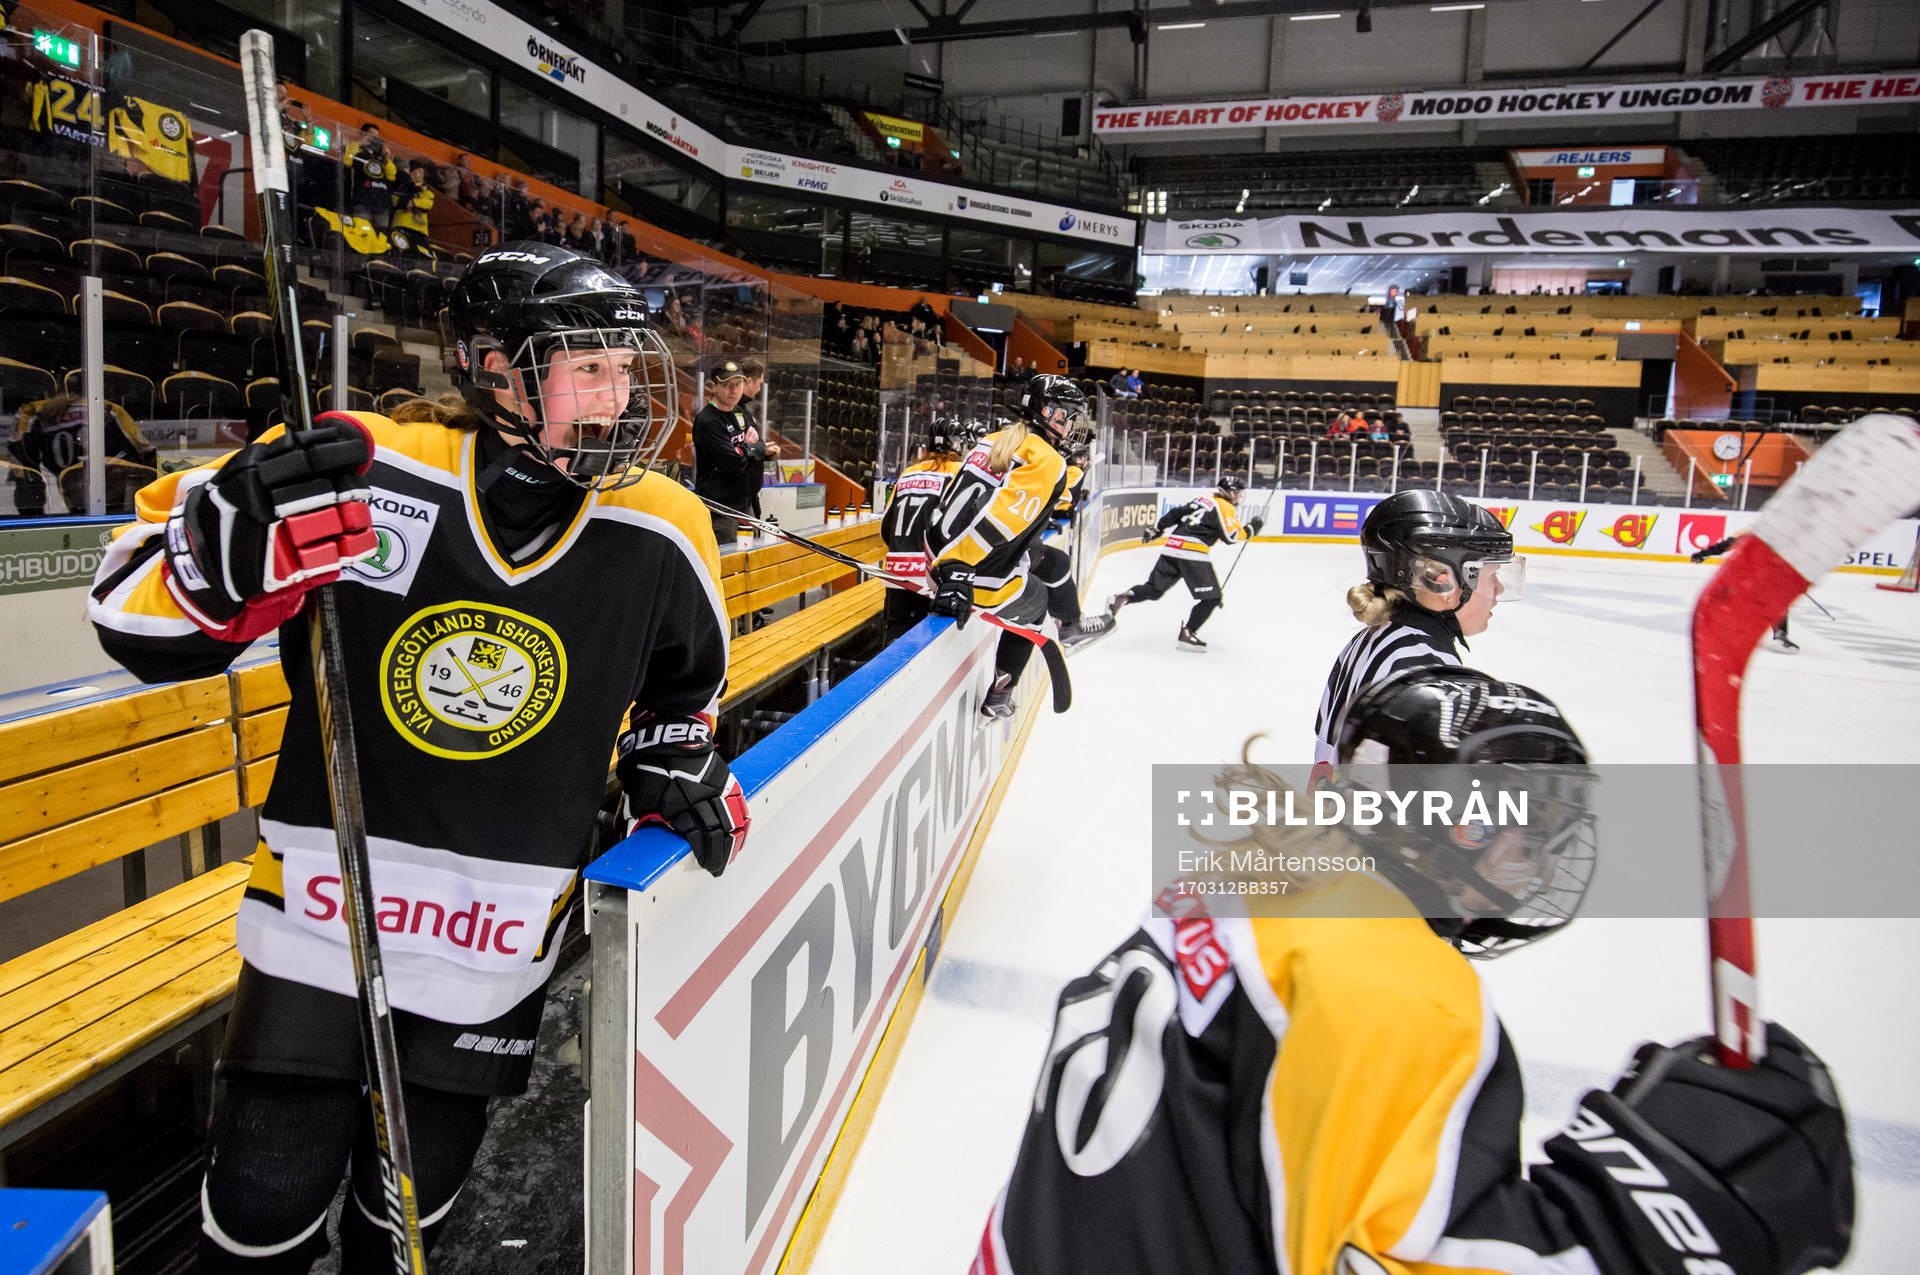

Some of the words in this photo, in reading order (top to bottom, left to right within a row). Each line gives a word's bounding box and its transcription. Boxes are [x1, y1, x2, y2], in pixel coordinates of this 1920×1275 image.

[1410, 95, 1493, 115] MODO
[1502, 91, 1615, 113] HOCKEY
[1619, 85, 1753, 108] UNGDOM
[1804, 80, 1865, 100] THE
[50, 79, 104, 129] 24
[1095, 112, 1140, 129] THE
[1144, 106, 1225, 127] HEART
[1229, 105, 1262, 123] OF
[1265, 100, 1371, 122] HOCKEY
[792, 160, 837, 174] KNIGHTEC
[1556, 151, 1631, 164] REJLERS
[754, 169, 780, 178] BEIJER
[797, 178, 829, 191] KPMG
[1078, 219, 1119, 237] IMERYS
[1300, 217, 1871, 249] Nordemans
[478, 251, 550, 265] CCM
[615, 309, 645, 321] CCM
[367, 496, 429, 523] KODA
[897, 496, 929, 536] 17
[1007, 490, 1041, 522] 20
[885, 561, 925, 572] CCM
[1843, 551, 1898, 567] SPEL
[393, 613, 486, 734] VÄSTERGÖTLANDS
[488, 620, 556, 746] ISHOCKEYFÖRBUND
[429, 664, 451, 680] 19
[498, 684, 522, 698] 46
[618, 723, 712, 754] AUER
[304, 875, 524, 955] Sandic
[1560, 1106, 1738, 1275] BAUE
